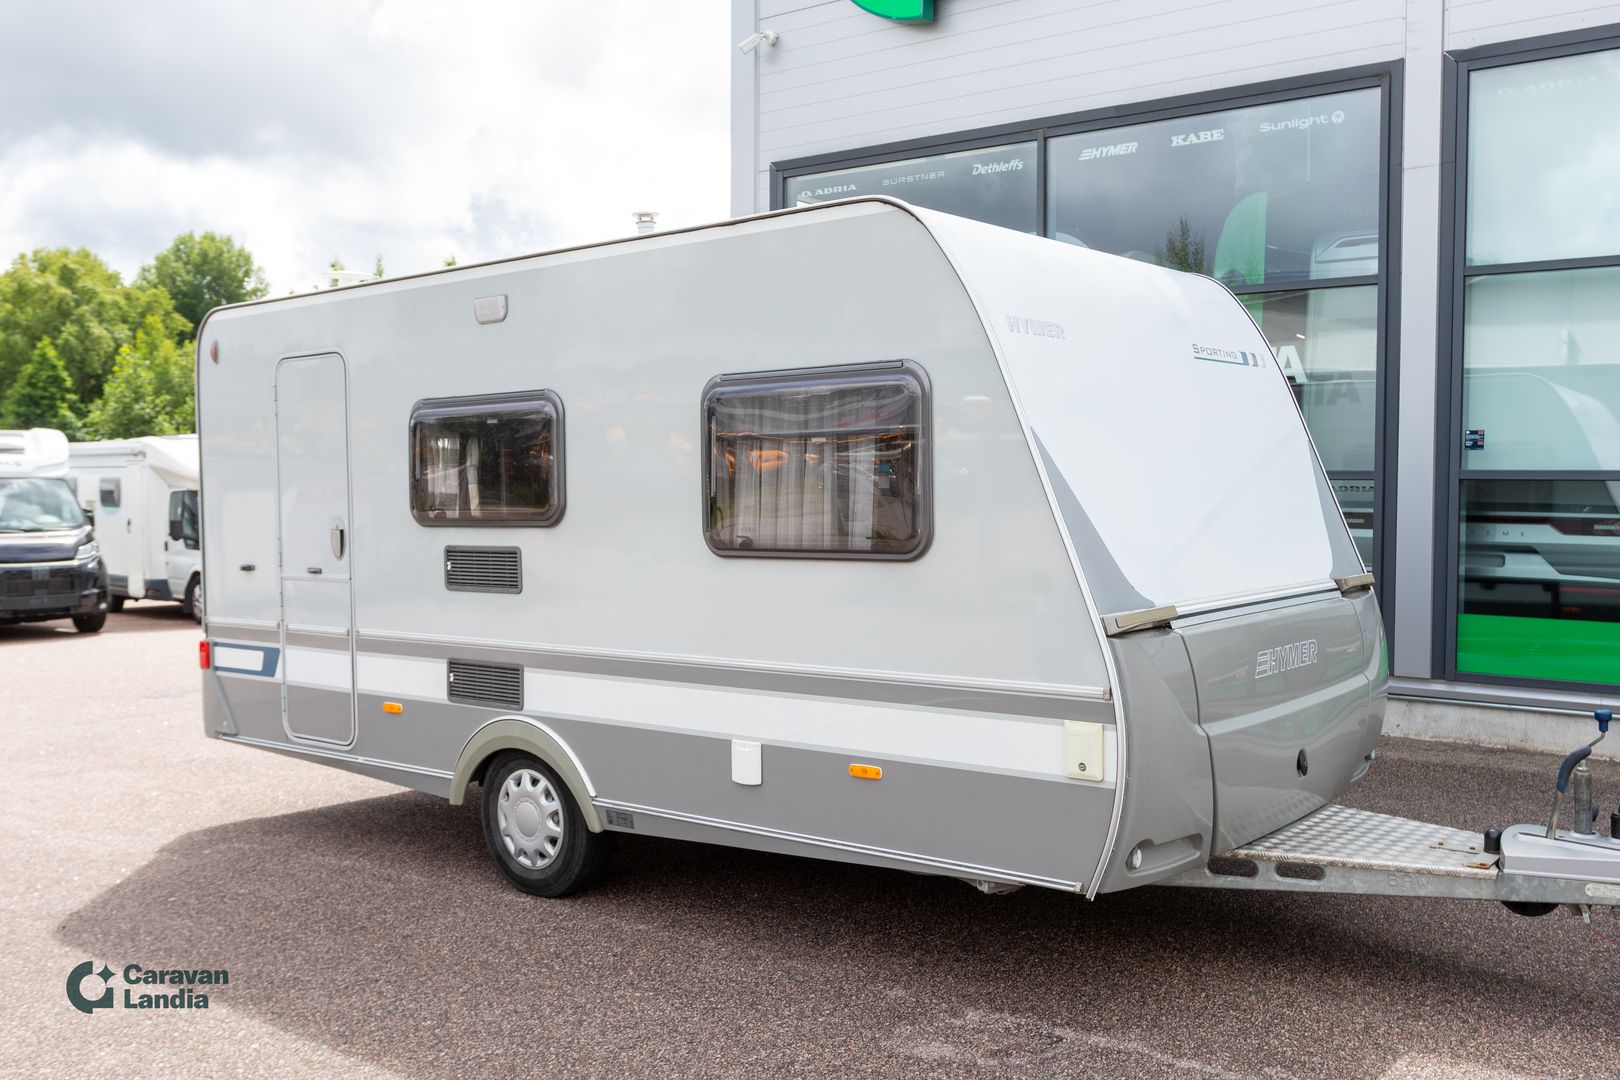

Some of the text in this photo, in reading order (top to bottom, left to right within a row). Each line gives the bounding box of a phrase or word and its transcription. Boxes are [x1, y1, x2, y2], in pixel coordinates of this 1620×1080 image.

[1259, 113, 1329, 133] Sunlight
[1170, 128, 1225, 147] KABE
[1078, 141, 1138, 161] HYMER
[971, 158, 1024, 176] Dethleffs
[814, 183, 857, 197] ADRIA
[1007, 313, 1066, 340] HYMER
[1255, 639, 1318, 679] HYMER
